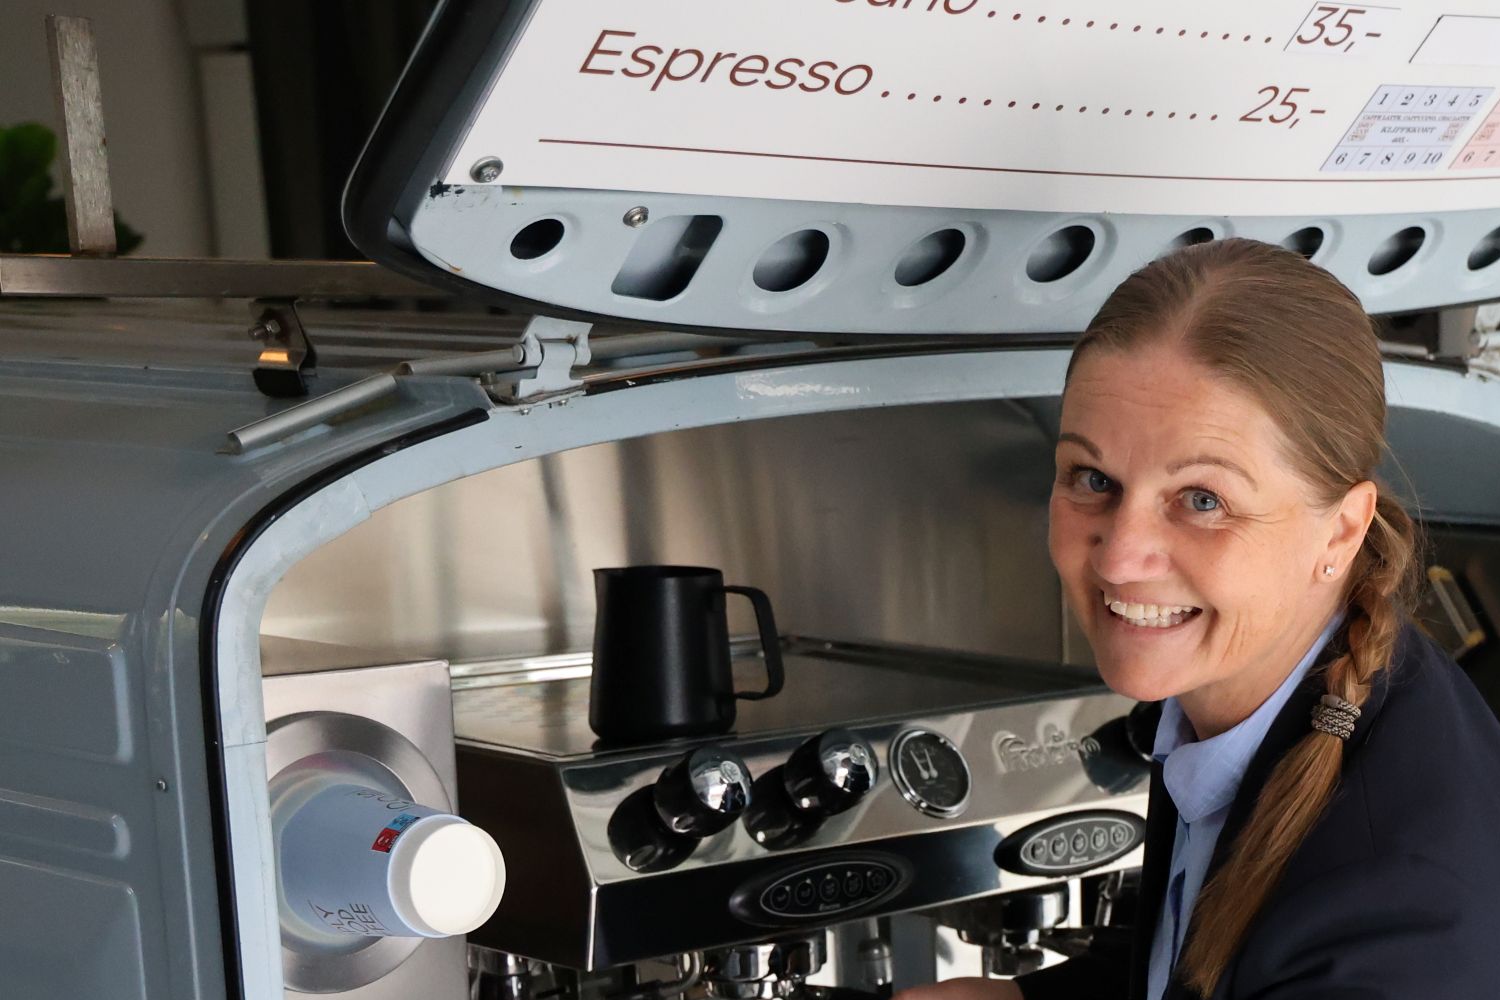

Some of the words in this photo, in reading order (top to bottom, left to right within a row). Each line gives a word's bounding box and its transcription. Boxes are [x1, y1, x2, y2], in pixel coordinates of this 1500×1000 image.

[1296, 5, 1382, 53] 35,-
[579, 29, 873, 96] Espresso
[1239, 87, 1327, 131] 25,-
[1377, 93, 1389, 105] 1
[1400, 93, 1414, 106] 2
[1423, 94, 1437, 106] 3
[1448, 94, 1460, 106] 4
[1469, 94, 1483, 107] 5
[1335, 153, 1348, 165] 6
[1358, 152, 1371, 165] 7
[1380, 153, 1394, 165] 8
[1403, 152, 1416, 165] 9
[1423, 152, 1443, 165] 10
[1462, 151, 1474, 163] 6
[1484, 150, 1496, 162] 7
